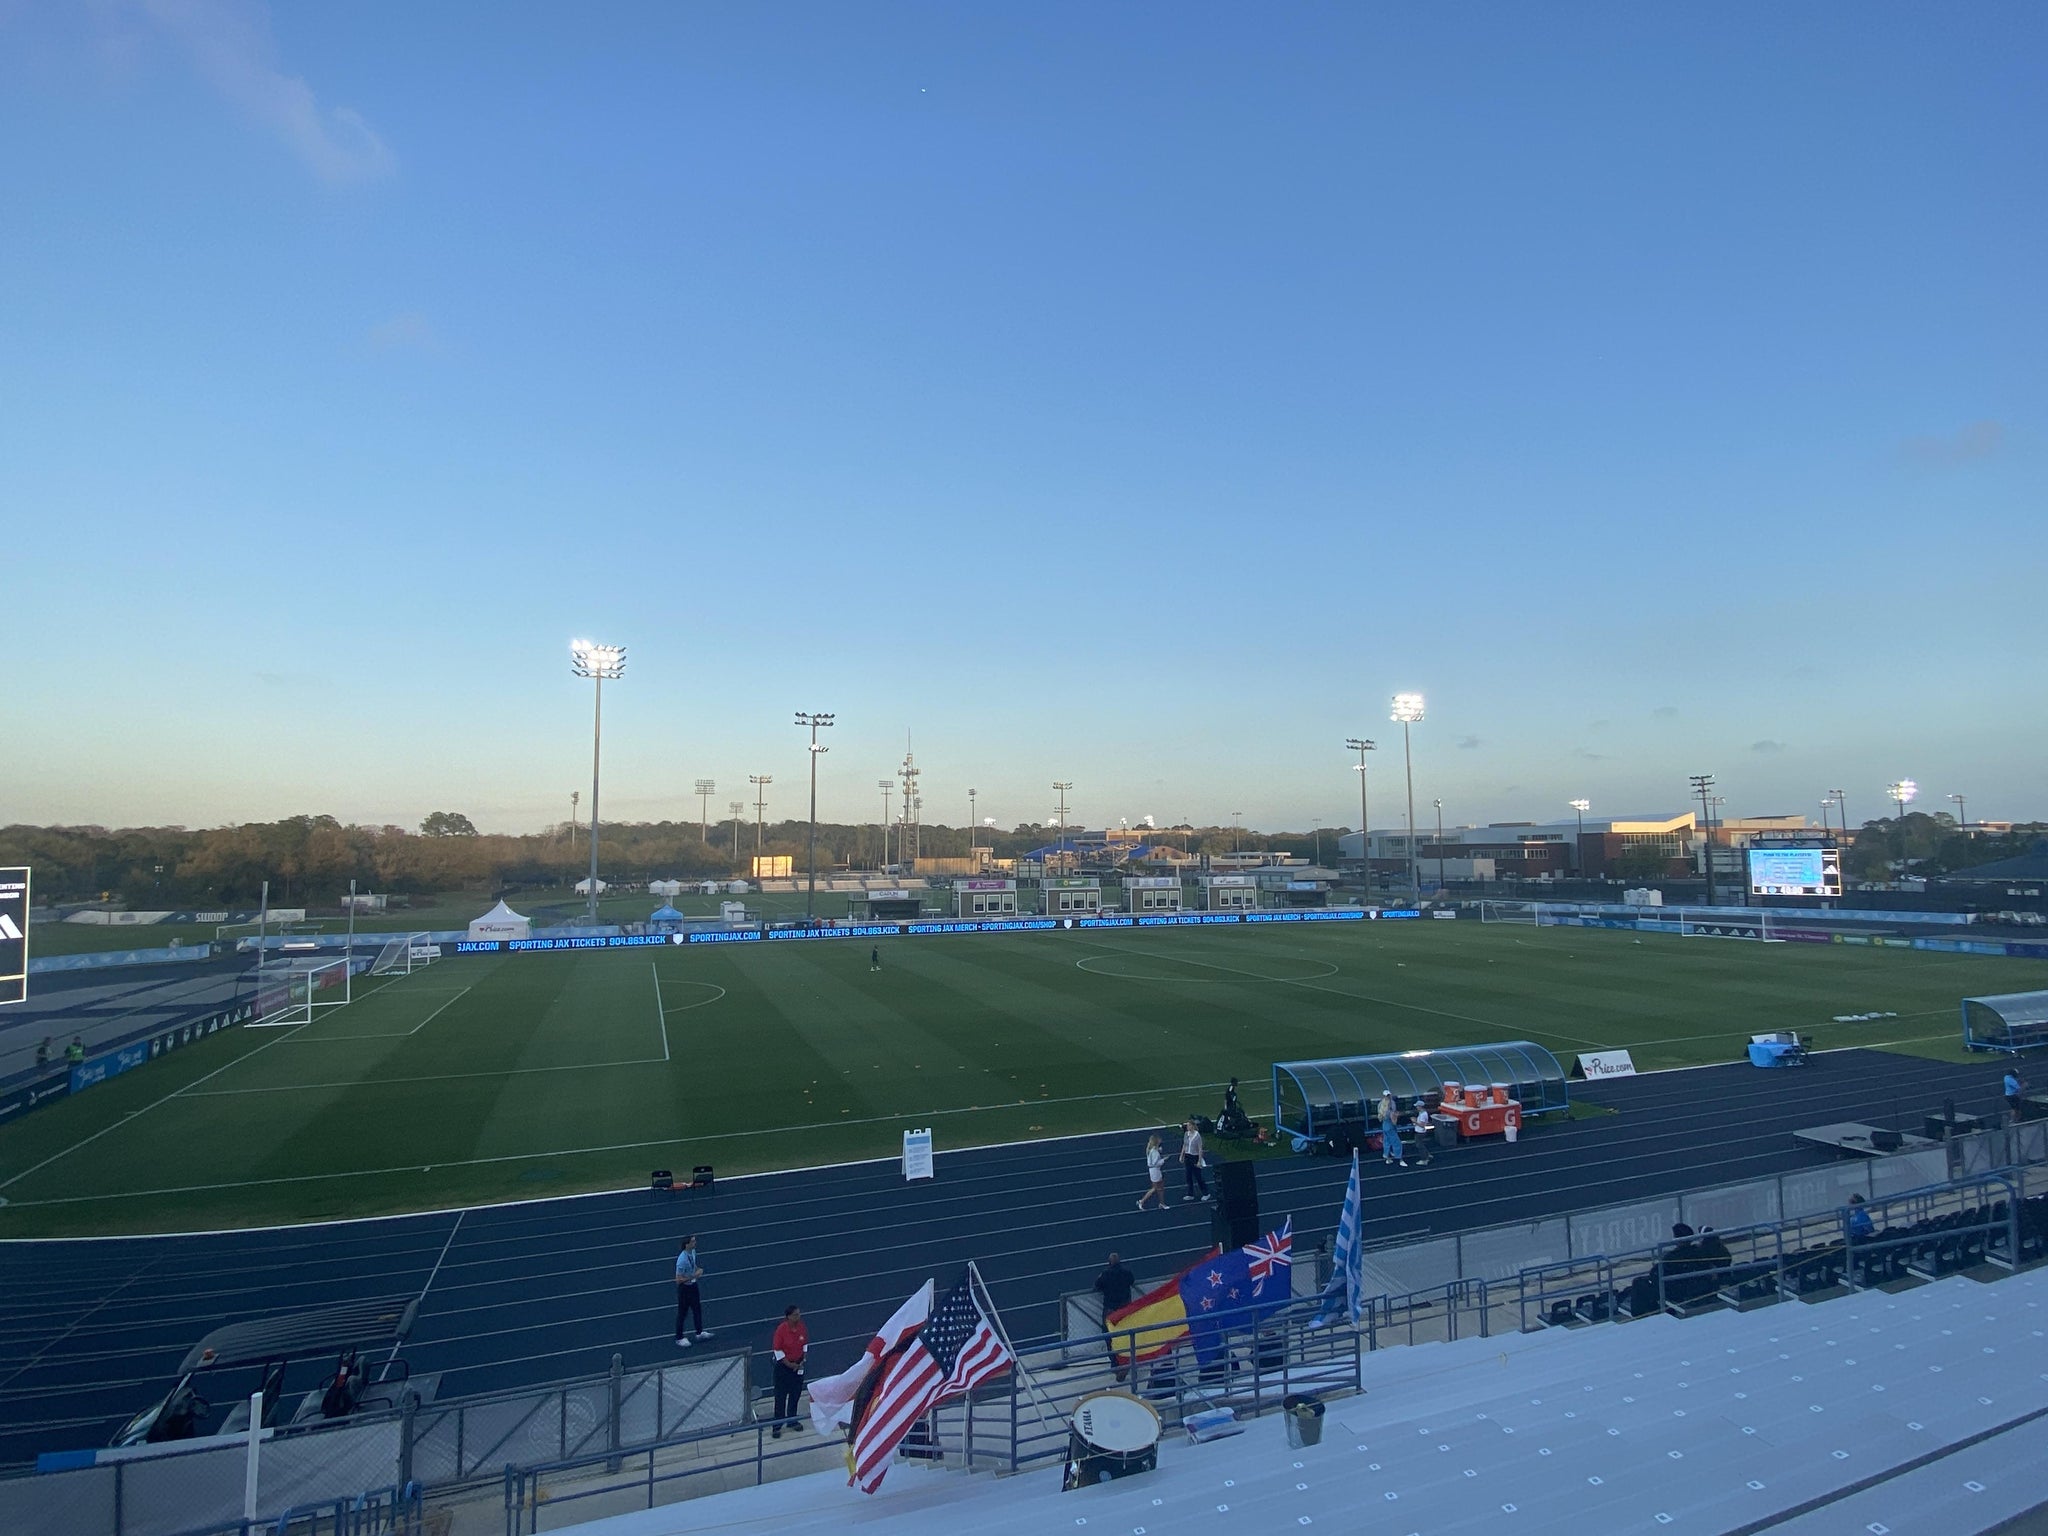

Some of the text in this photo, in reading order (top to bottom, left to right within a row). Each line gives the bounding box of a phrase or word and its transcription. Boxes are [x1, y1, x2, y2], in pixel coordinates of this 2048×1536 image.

[195, 912, 229, 923] SWOOP
[1080, 918, 1133, 927] SPORTINGJAX.COM
[1138, 917, 1167, 925] SPORTING
[769, 926, 900, 939] SPORTING JAX TICKETS 904.863.KICK
[908, 925, 942, 933] SPORTING
[942, 924, 954, 932] JAX
[954, 923, 977, 932] MERCH
[509, 936, 666, 950] SPORTING JAX TICKETS 904.863.KICK
[690, 932, 761, 942] SPORTINGJAX.COM
[1591, 1058, 1633, 1075] Price.com
[1468, 1112, 1480, 1131] G
[1504, 1109, 1516, 1126] G
